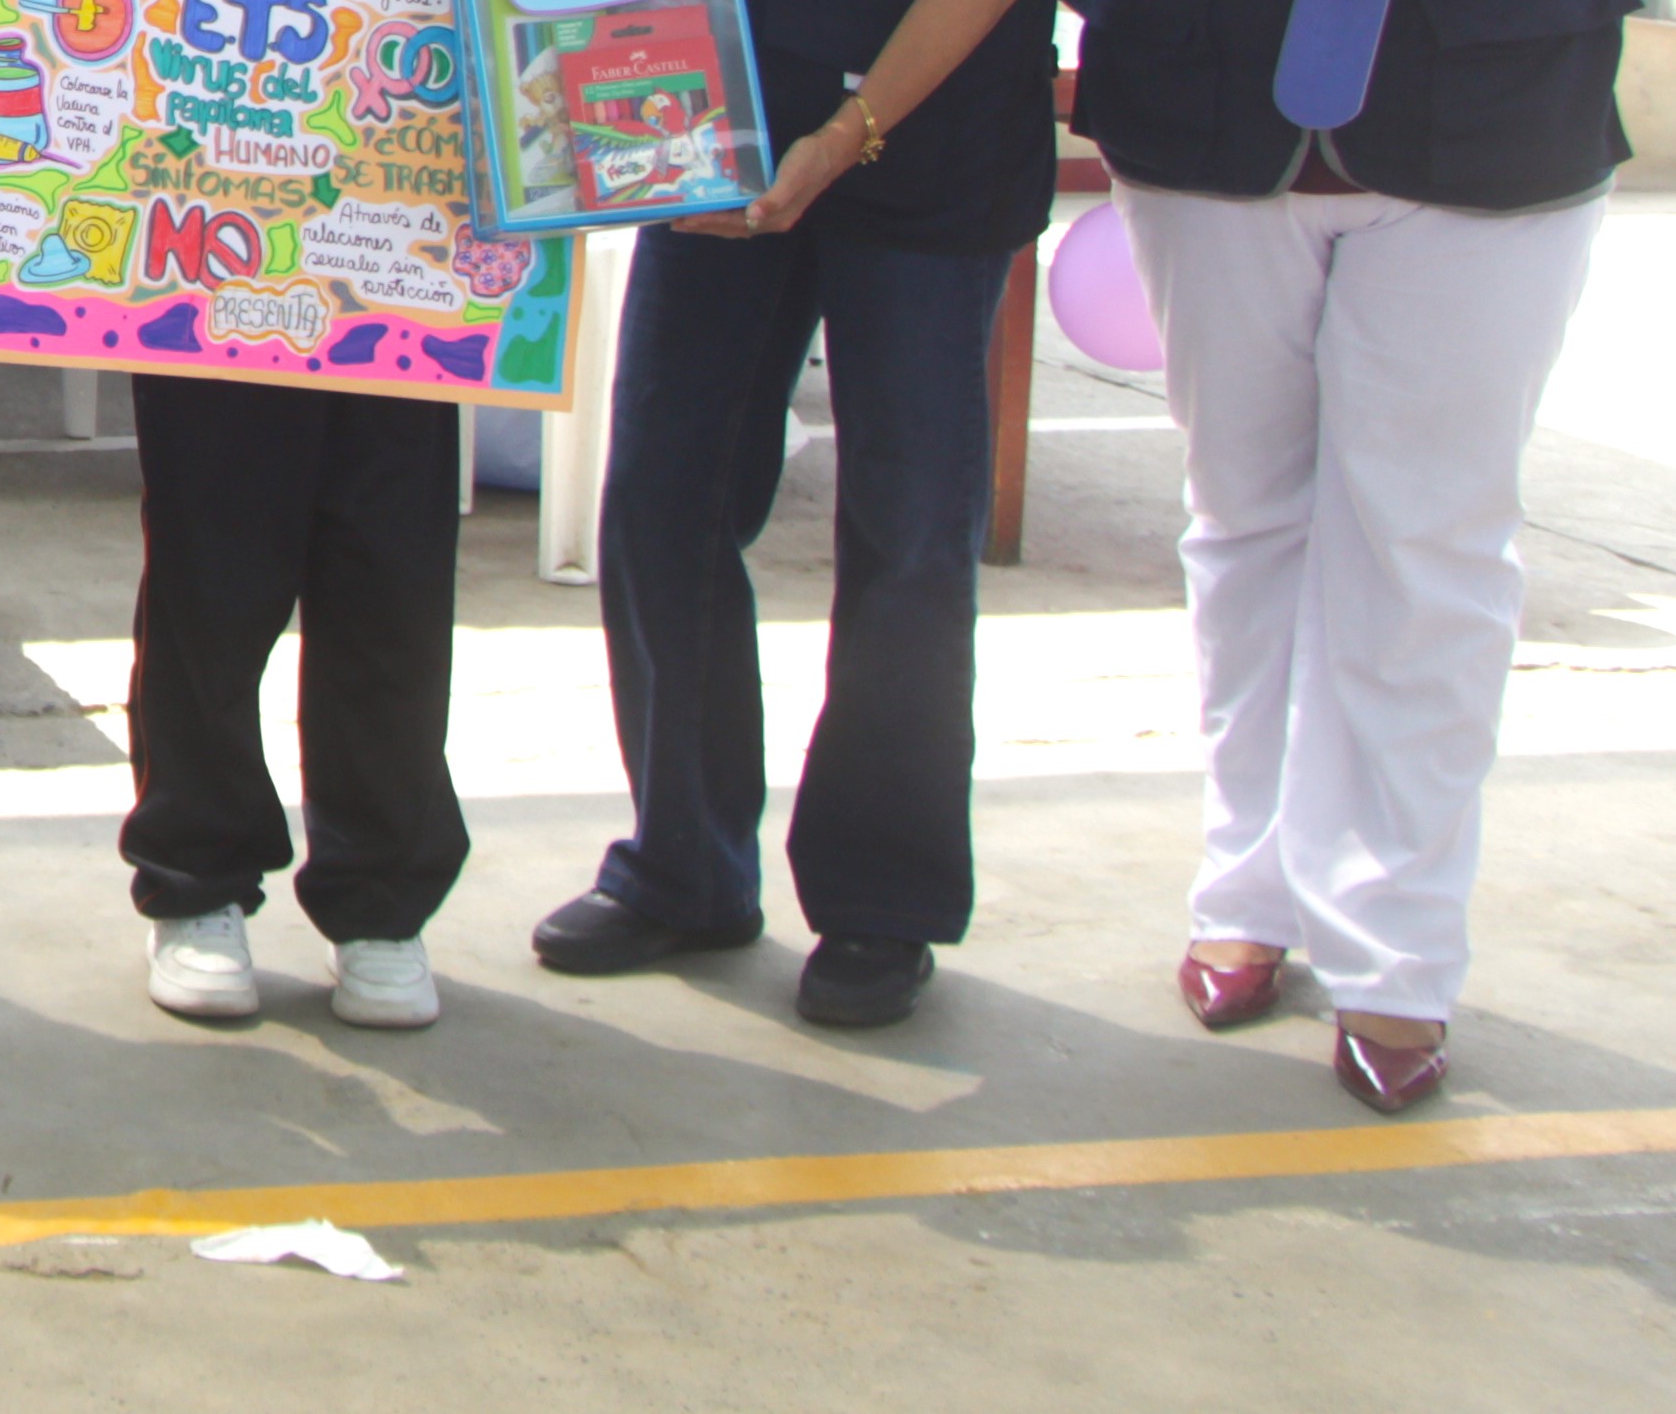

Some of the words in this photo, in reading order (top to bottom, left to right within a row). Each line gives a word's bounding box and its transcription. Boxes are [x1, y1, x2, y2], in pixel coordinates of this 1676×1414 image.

[263, 61, 319, 103] del
[591, 58, 689, 80] FABER-CASTELL
[166, 89, 294, 137] papiloma
[213, 126, 331, 169] HUMANO
[333, 153, 374, 188] SE
[301, 222, 393, 253] relaciones
[419, 212, 443, 235] de
[143, 196, 263, 294] NO
[305, 250, 381, 275] sexuales
[387, 255, 425, 280] sin
[212, 292, 323, 338] PRESENTA
